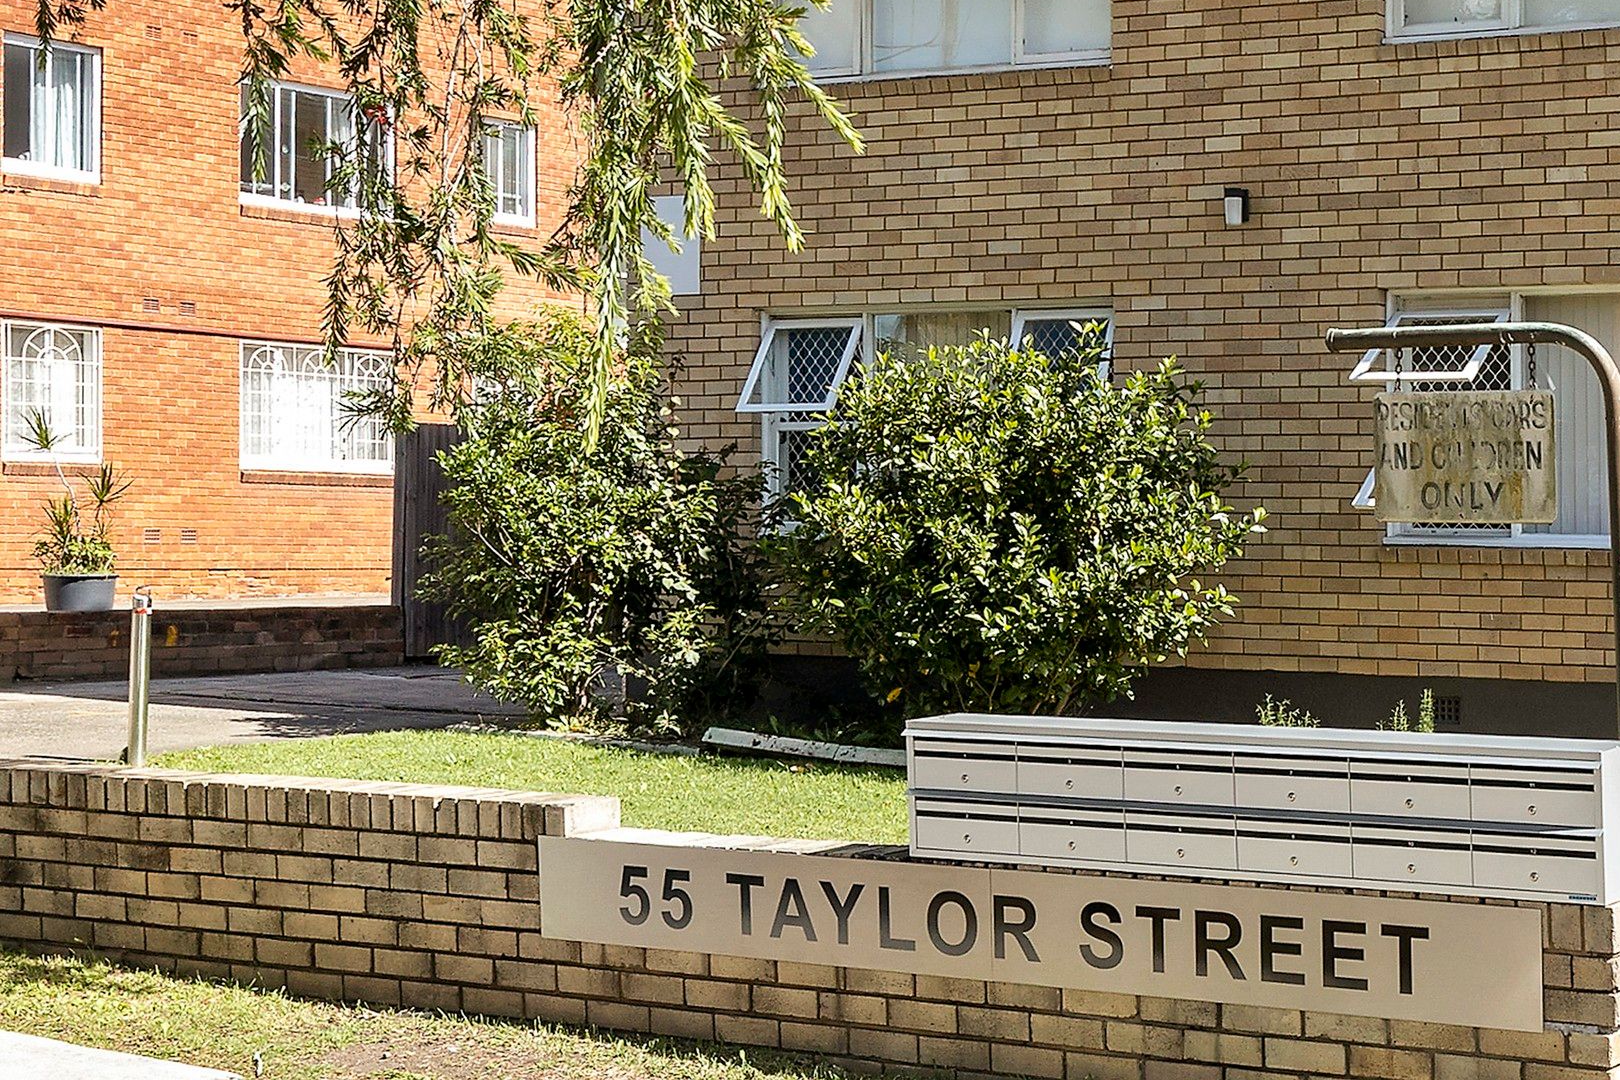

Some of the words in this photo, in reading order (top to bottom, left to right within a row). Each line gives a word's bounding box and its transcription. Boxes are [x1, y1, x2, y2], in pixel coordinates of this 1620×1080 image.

[1379, 441, 1424, 470] AND
[1431, 440, 1543, 470] CHLDREN
[1420, 481, 1506, 511] ONLY
[619, 865, 693, 930] 55
[725, 872, 1041, 963] TAYLOR
[1079, 901, 1430, 995] STREET
